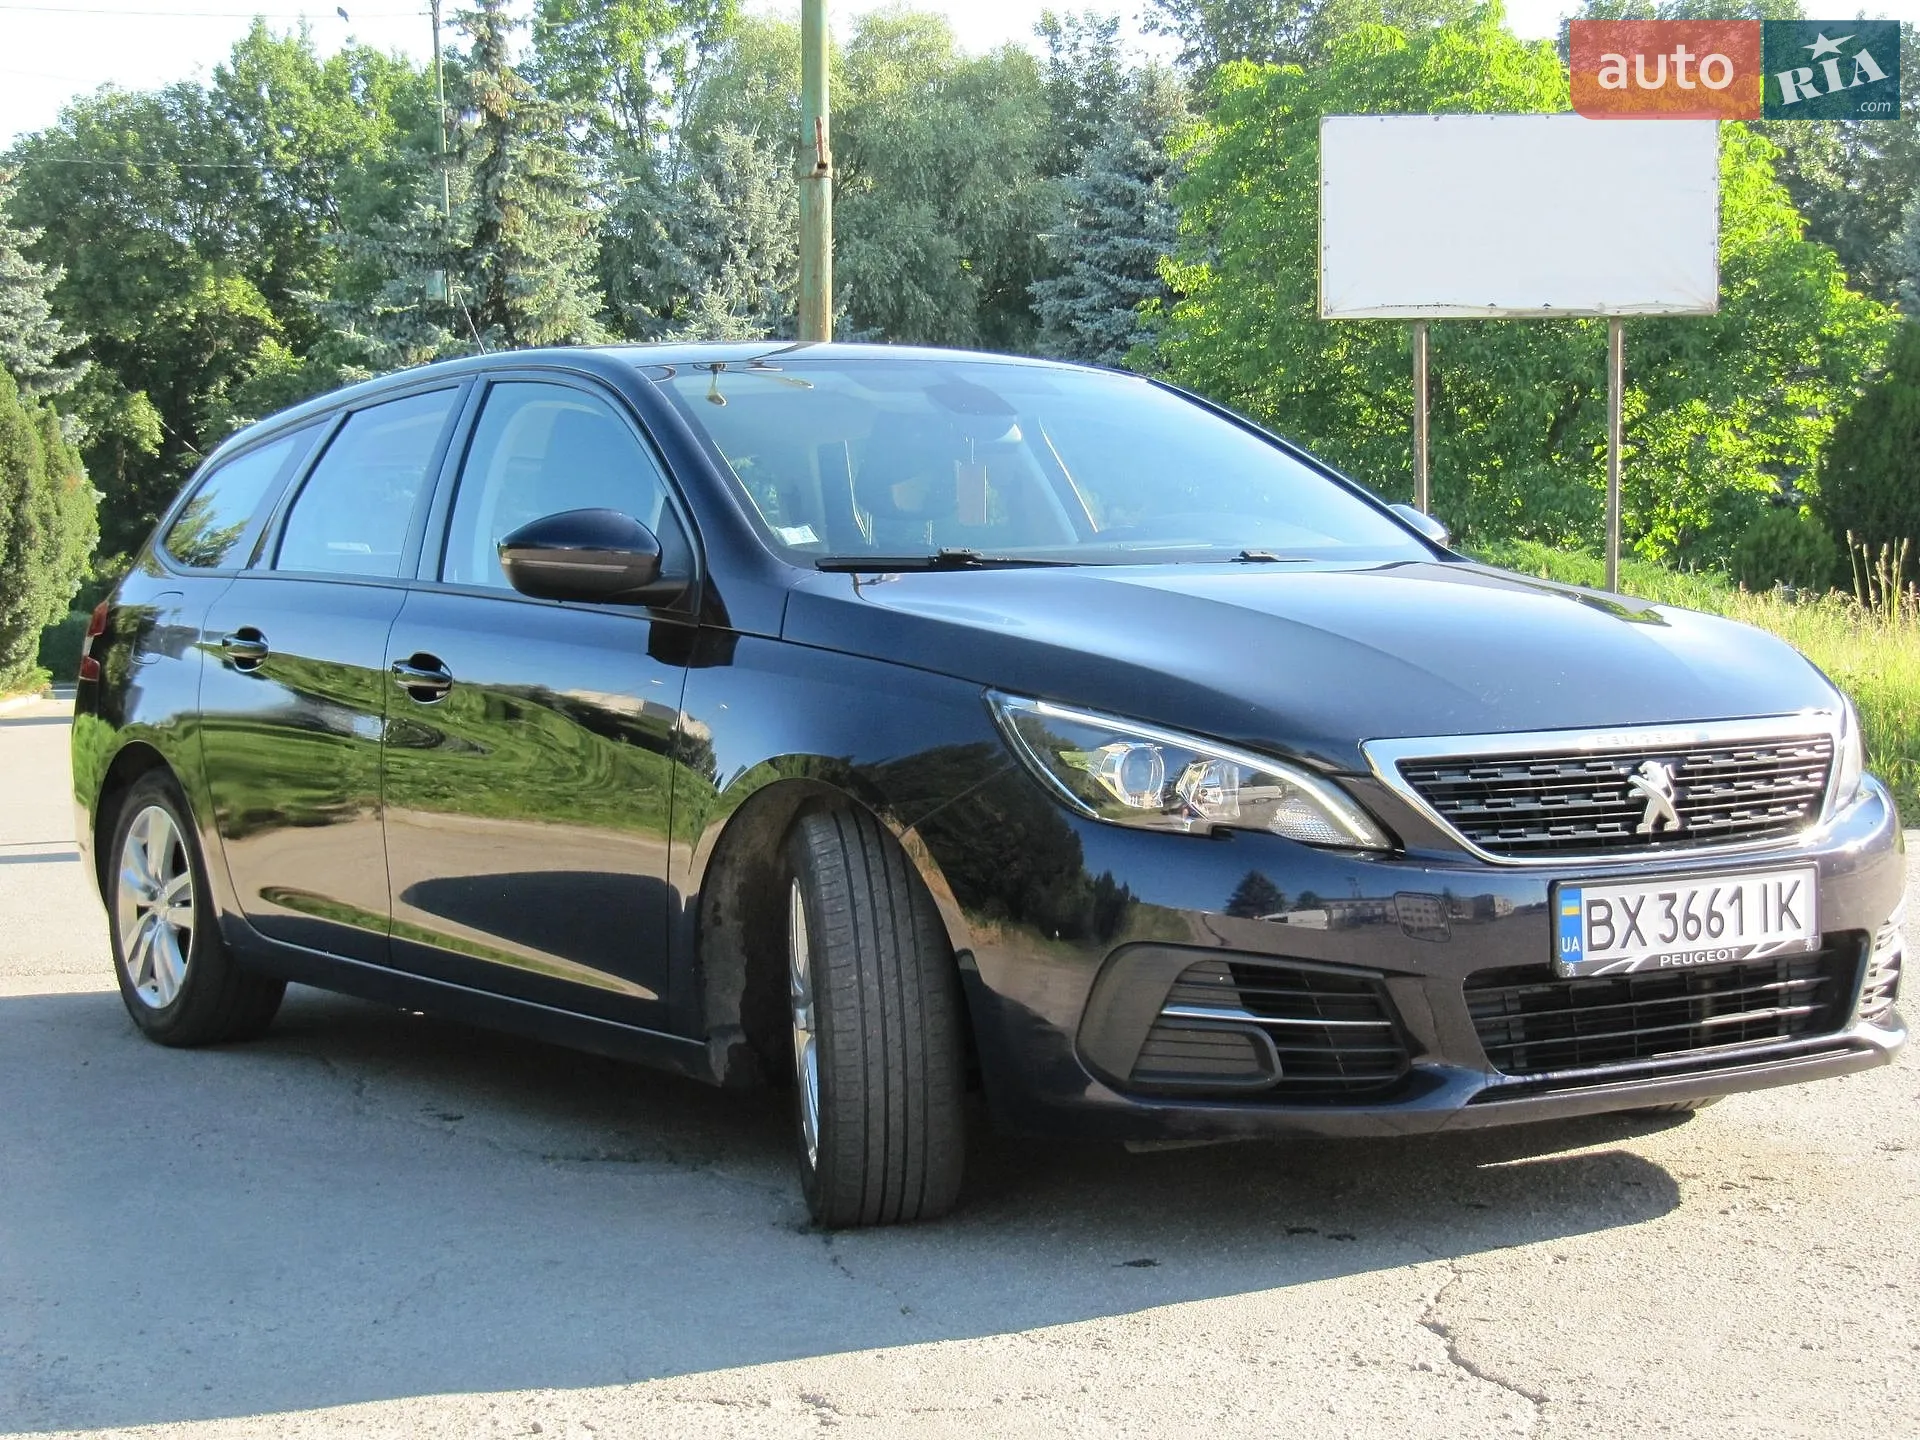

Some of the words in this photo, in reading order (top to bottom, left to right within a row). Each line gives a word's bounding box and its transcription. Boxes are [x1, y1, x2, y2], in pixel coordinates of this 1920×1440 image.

[1586, 894, 1648, 952] BX
[1658, 885, 1744, 944] 3661
[1760, 879, 1802, 933] IK
[1561, 936, 1580, 953] UA
[1659, 947, 1740, 967] PEUGEOT
